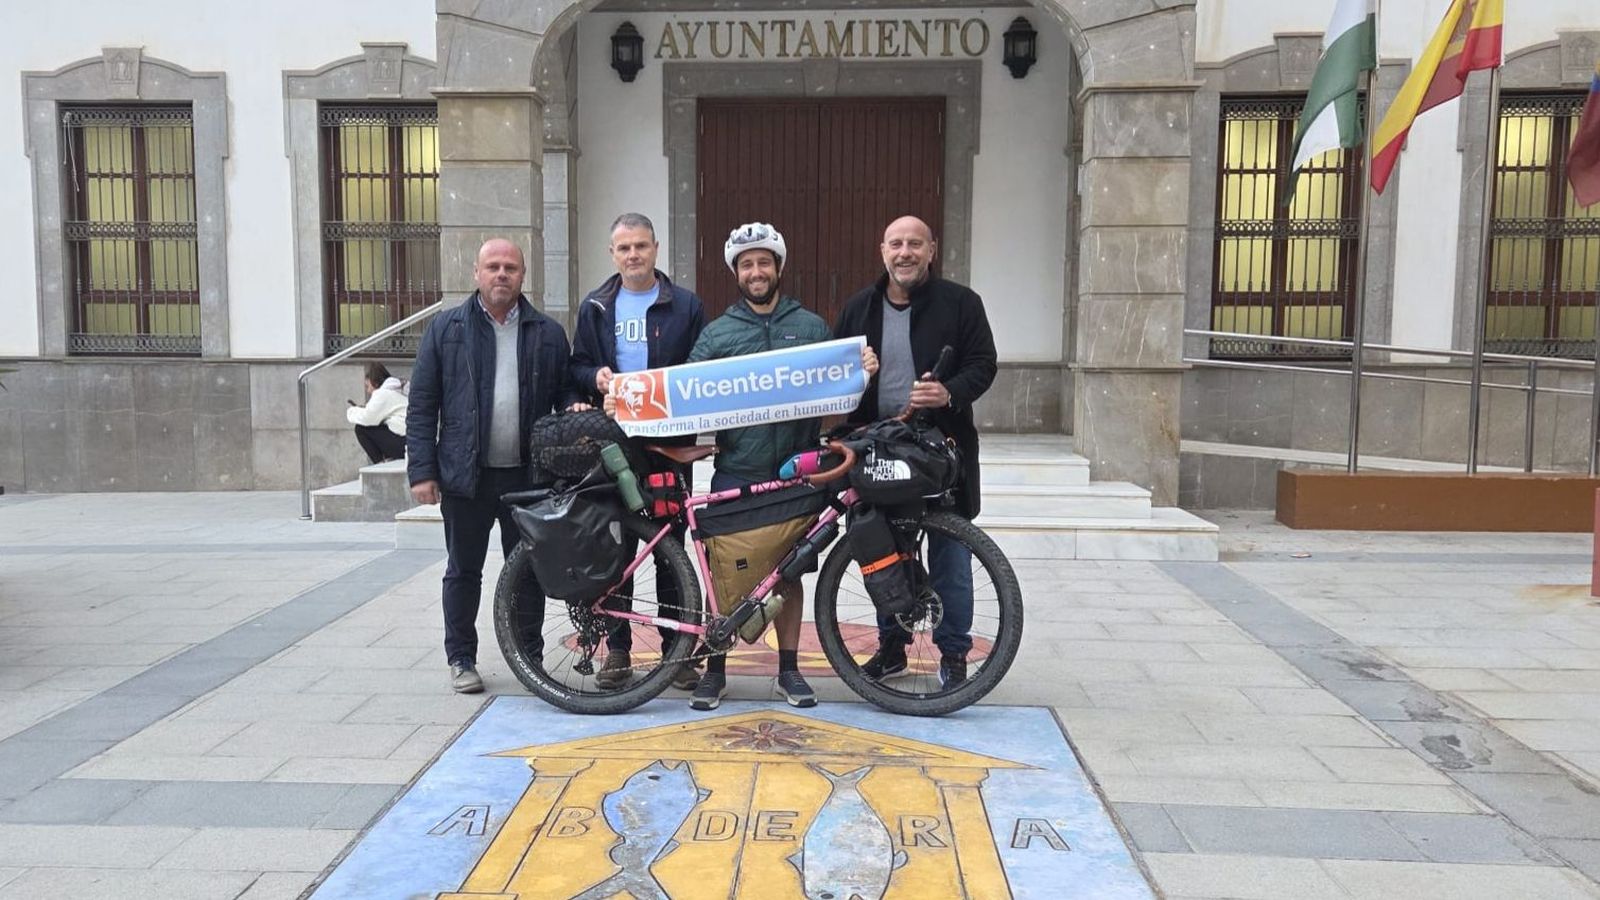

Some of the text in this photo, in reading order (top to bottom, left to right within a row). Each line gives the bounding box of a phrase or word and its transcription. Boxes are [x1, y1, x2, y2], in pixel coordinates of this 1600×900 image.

[655, 19, 990, 58] AYUNTAMIENTO
[676, 361, 854, 400] VicenteFerrer
[622, 419, 694, 436] Transforma
[699, 417, 710, 429] la
[714, 408, 770, 427] sociedad
[774, 407, 789, 418] en
[864, 466, 894, 475] NORTH
[877, 459, 894, 467] THE
[872, 473, 894, 481] FACE
